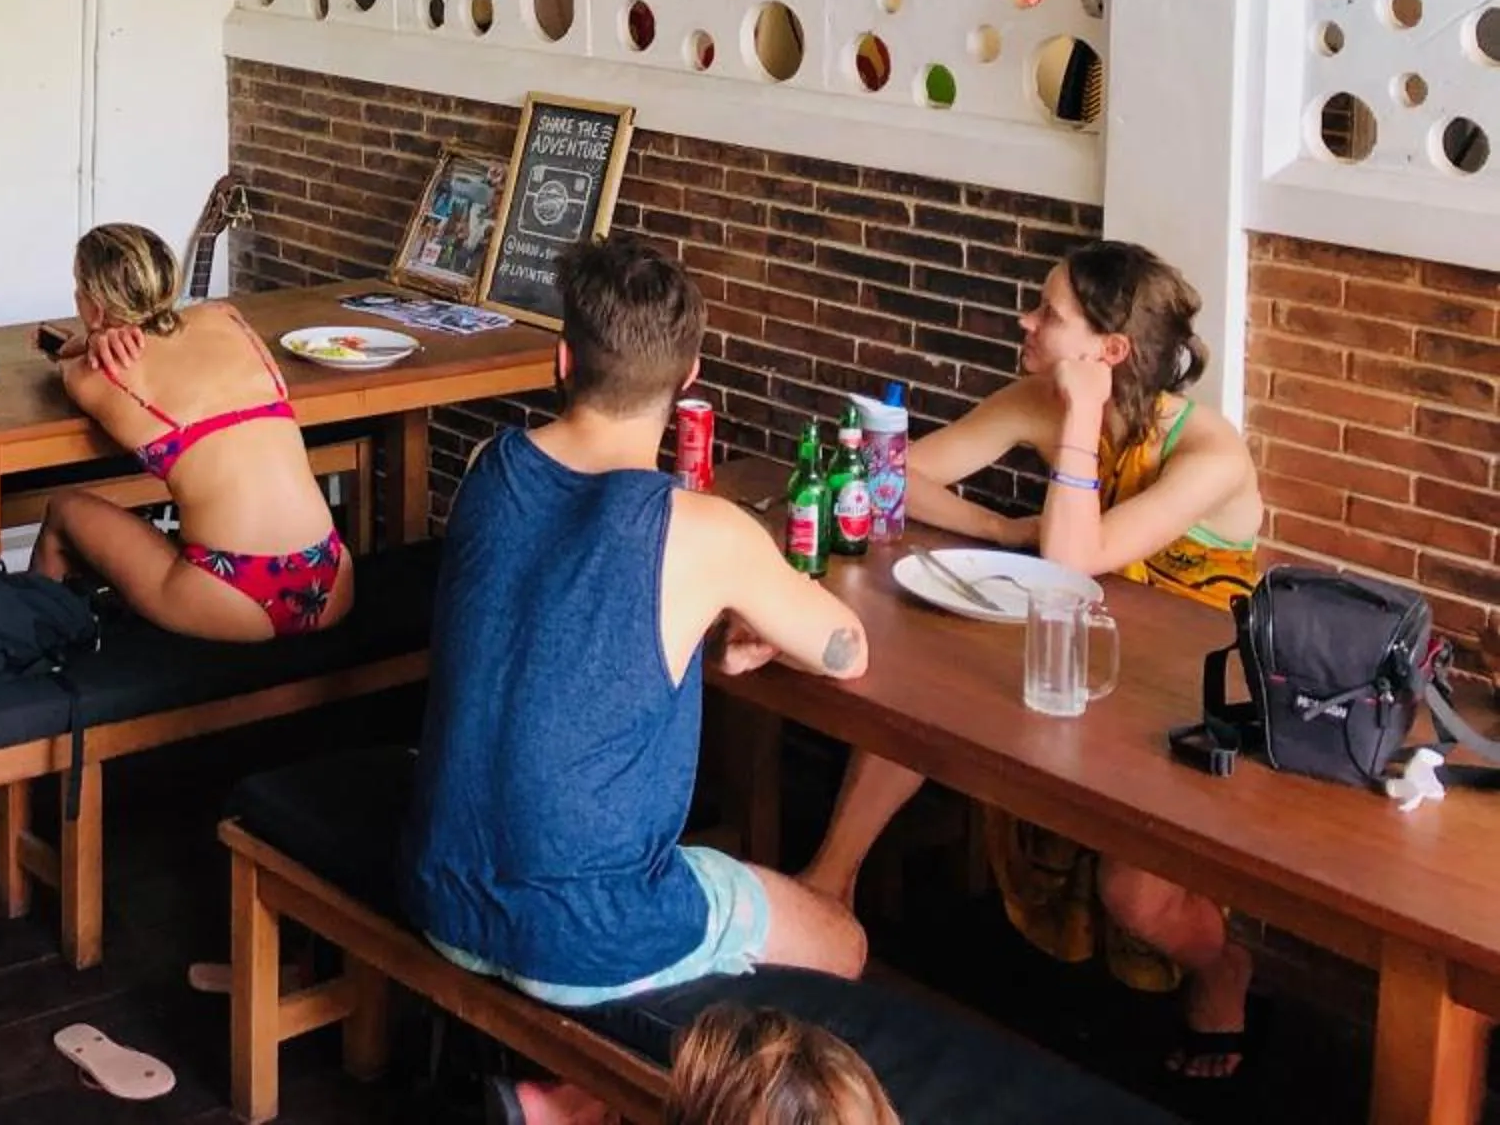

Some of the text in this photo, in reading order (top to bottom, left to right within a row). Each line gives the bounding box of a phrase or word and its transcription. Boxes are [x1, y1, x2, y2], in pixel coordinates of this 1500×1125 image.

[538, 116, 601, 138] SHARE THE
[531, 133, 609, 160] ADVENTURE
